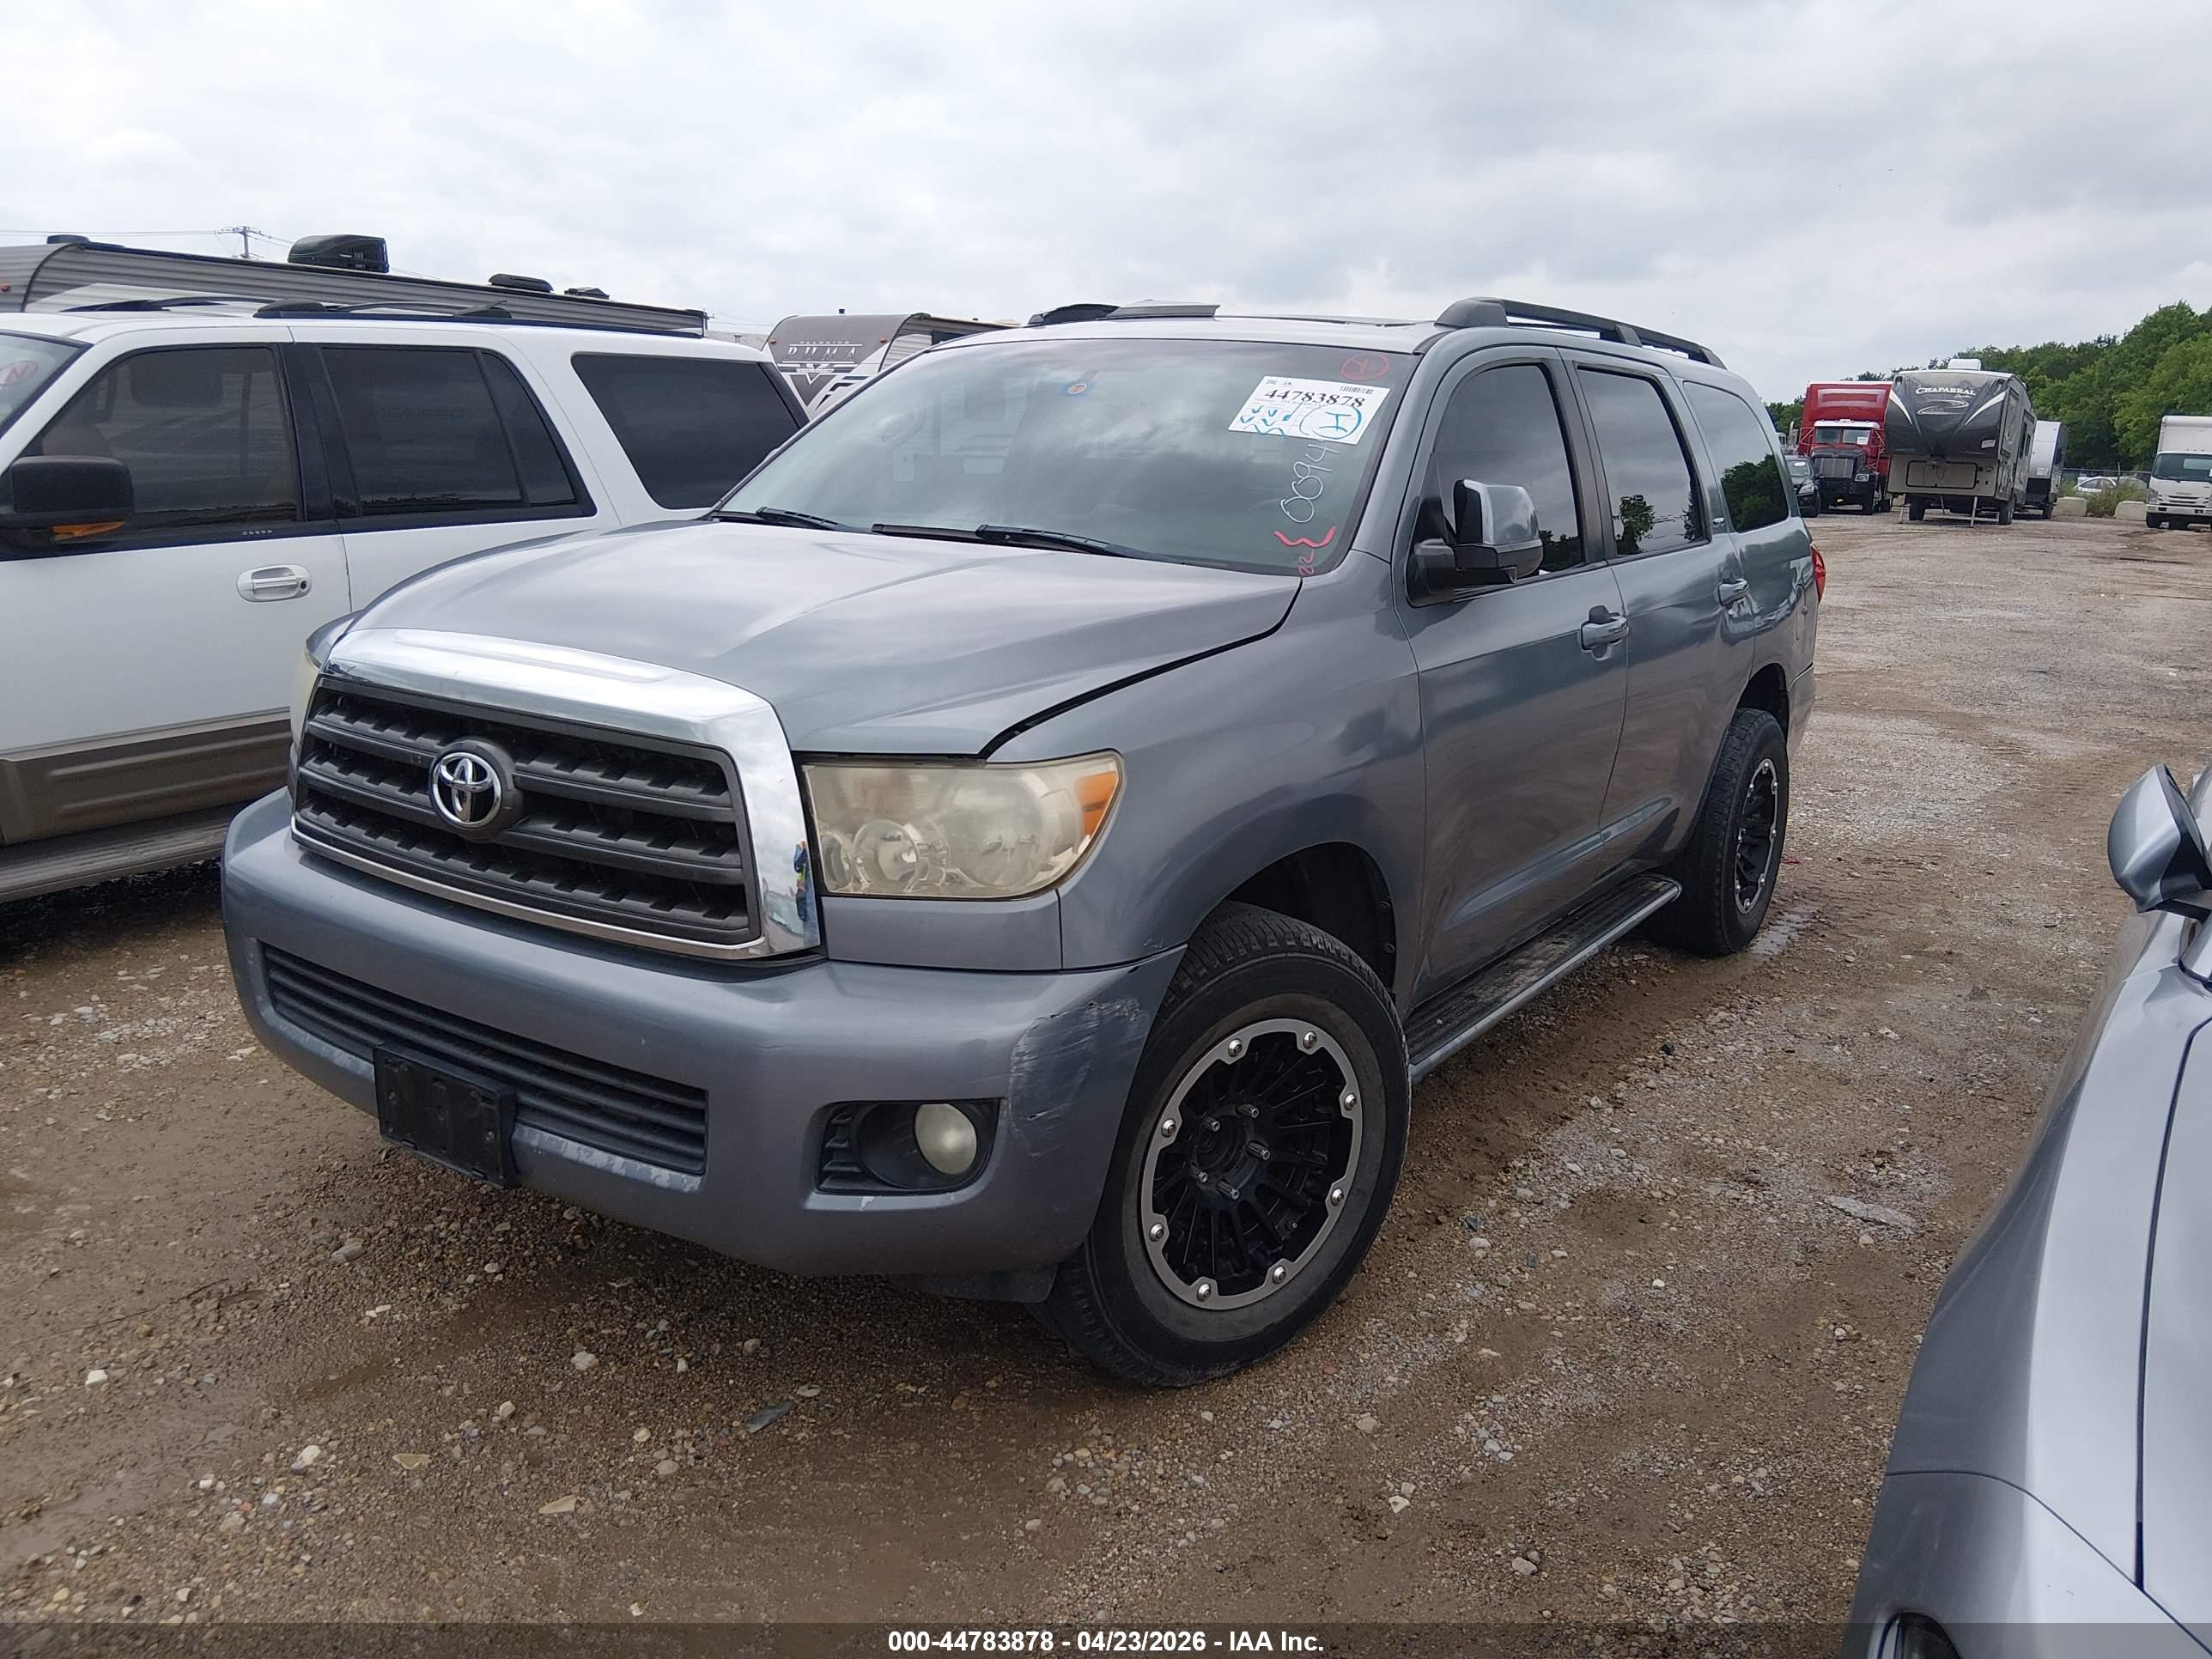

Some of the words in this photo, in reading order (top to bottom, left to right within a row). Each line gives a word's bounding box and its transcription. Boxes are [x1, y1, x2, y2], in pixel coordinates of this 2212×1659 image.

[1264, 388, 1366, 408] 44783878
[1916, 386, 1977, 396] CHAPARRAL
[1279, 439, 1340, 523] 0094
